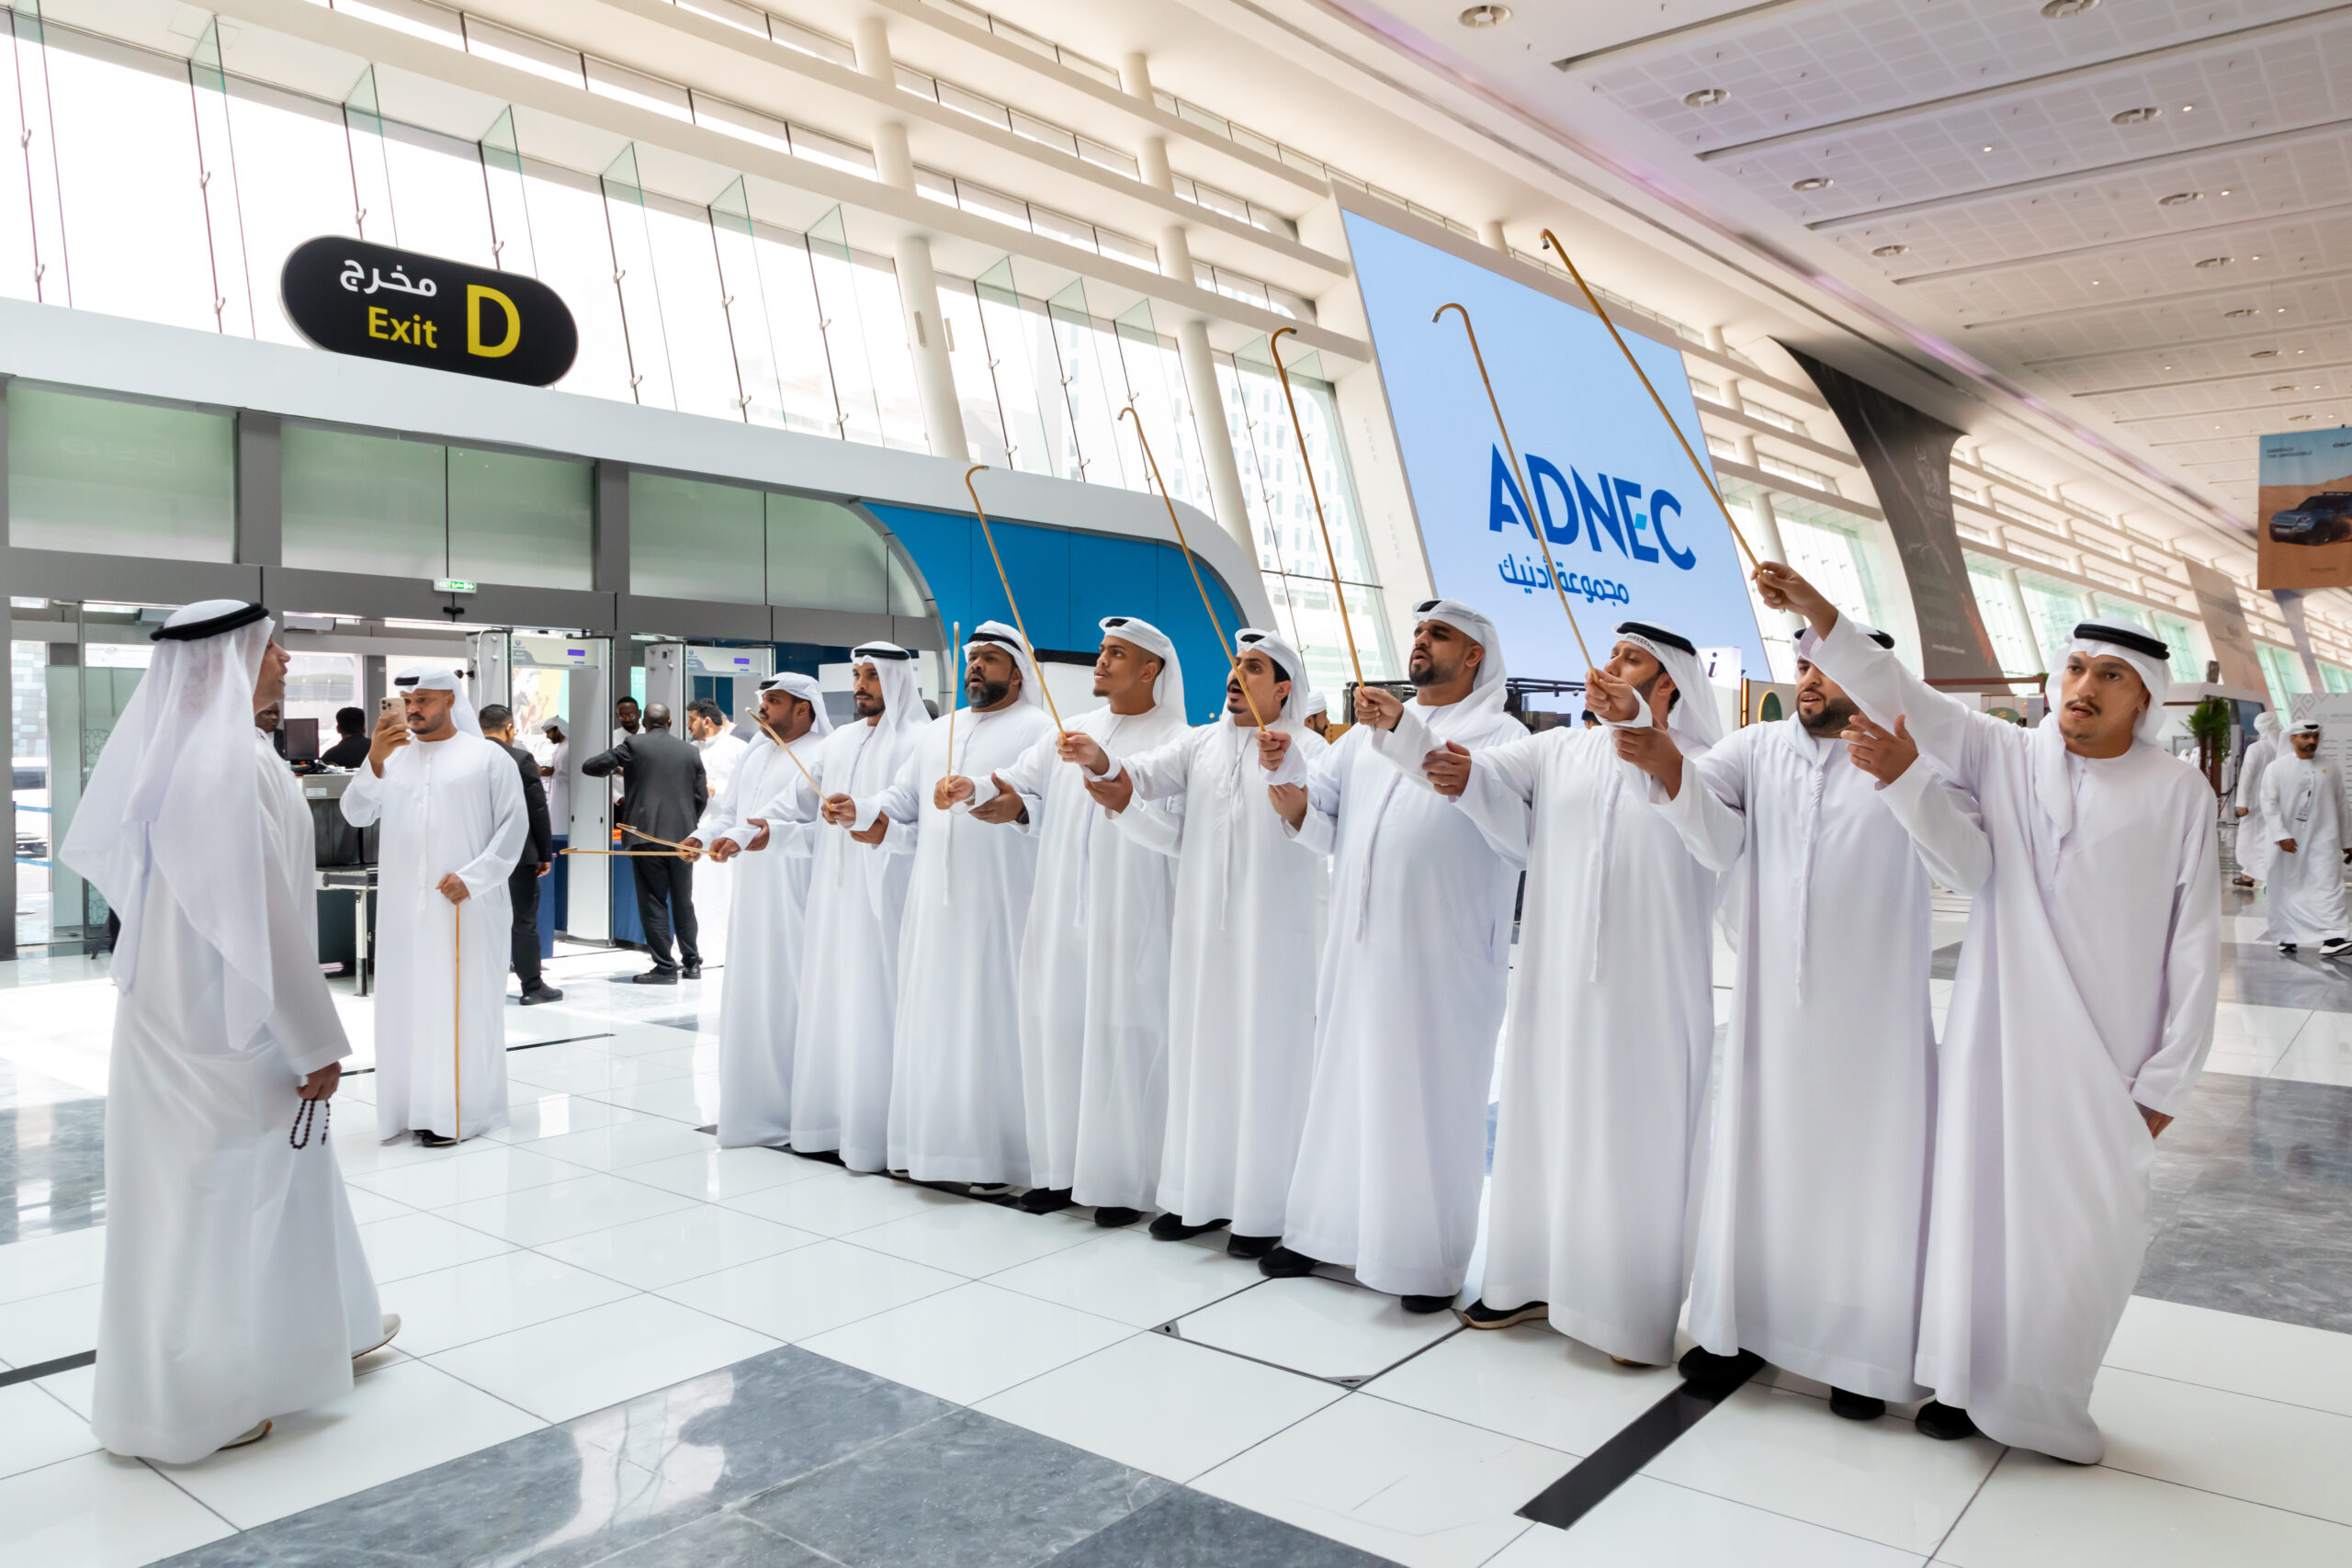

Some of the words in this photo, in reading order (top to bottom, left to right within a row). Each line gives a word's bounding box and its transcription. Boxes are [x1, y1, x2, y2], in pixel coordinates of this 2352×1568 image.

[340, 259, 437, 298] مخرج
[368, 306, 437, 349] Exit
[467, 284, 521, 358] D
[1489, 442, 1697, 571] ADNEC
[1498, 553, 1556, 594] أدنيك
[1556, 561, 1630, 607] مجموعة
